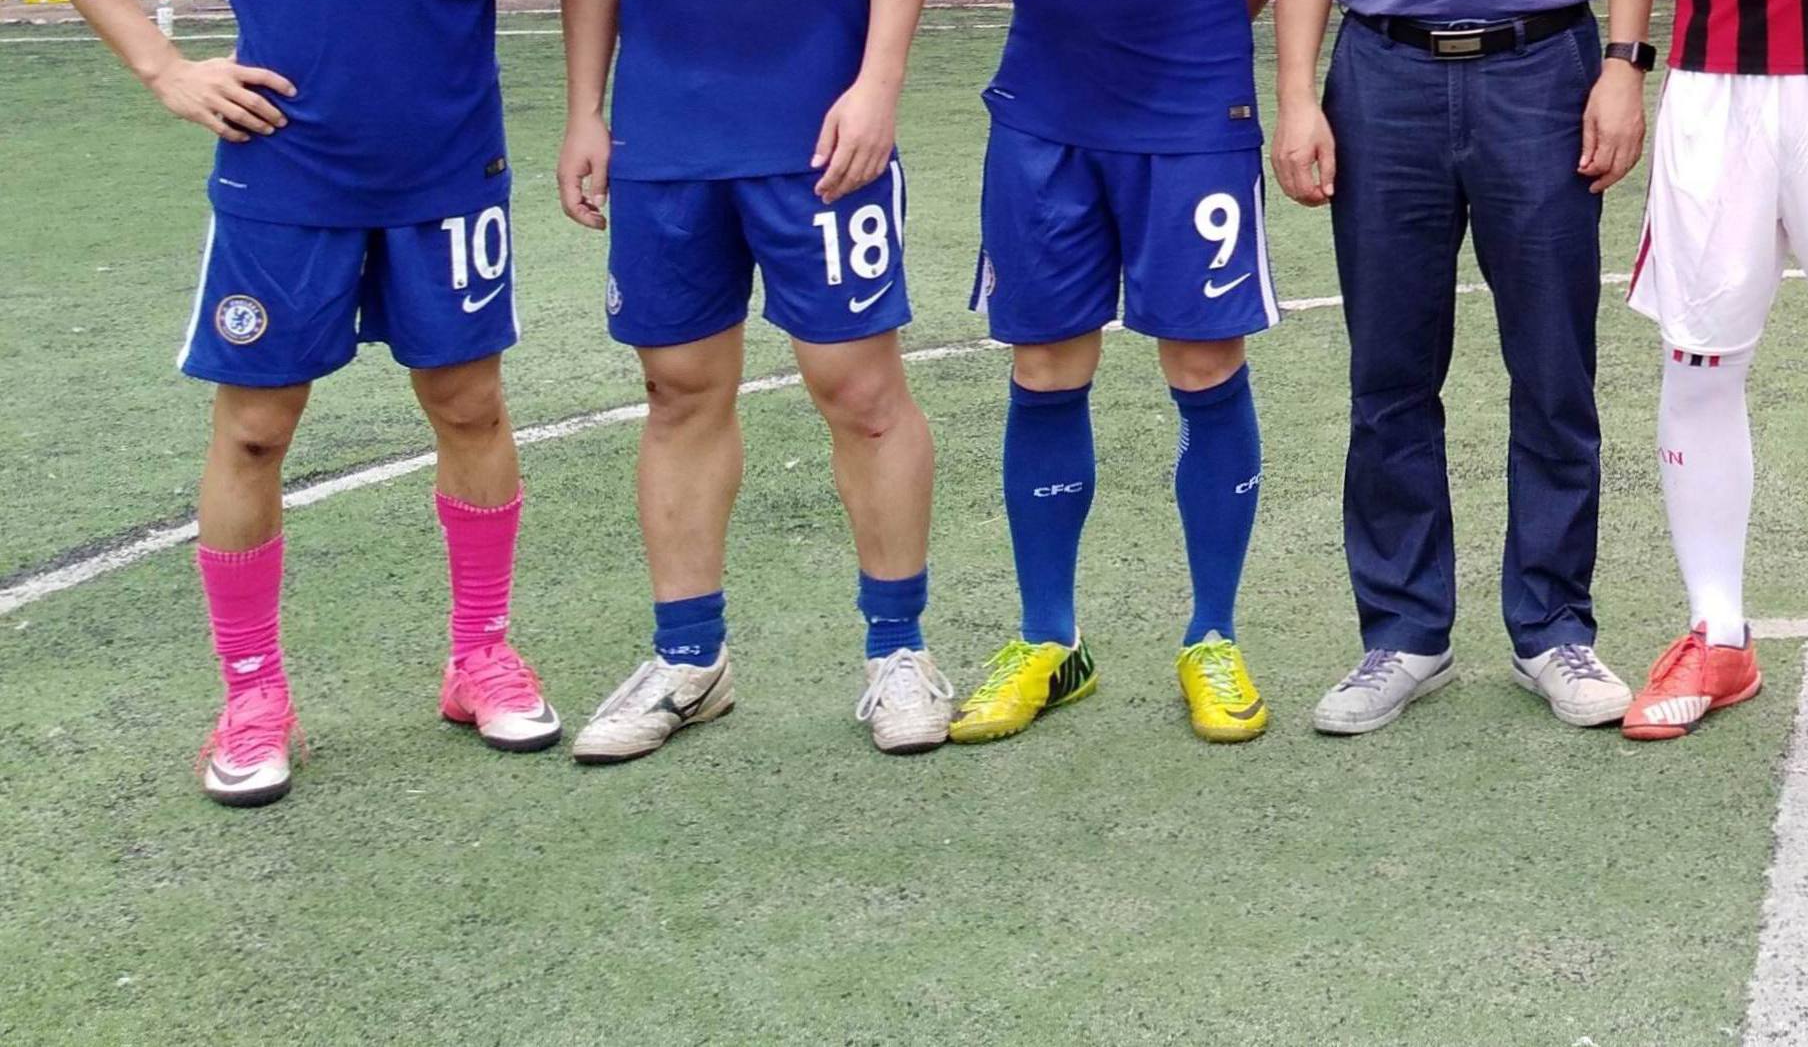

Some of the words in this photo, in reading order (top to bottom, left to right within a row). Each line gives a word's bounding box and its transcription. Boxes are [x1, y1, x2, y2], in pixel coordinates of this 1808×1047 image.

[441, 205, 508, 290] 10
[813, 204, 889, 285] 18
[1194, 192, 1240, 269] 9
[1033, 481, 1084, 498] CFC
